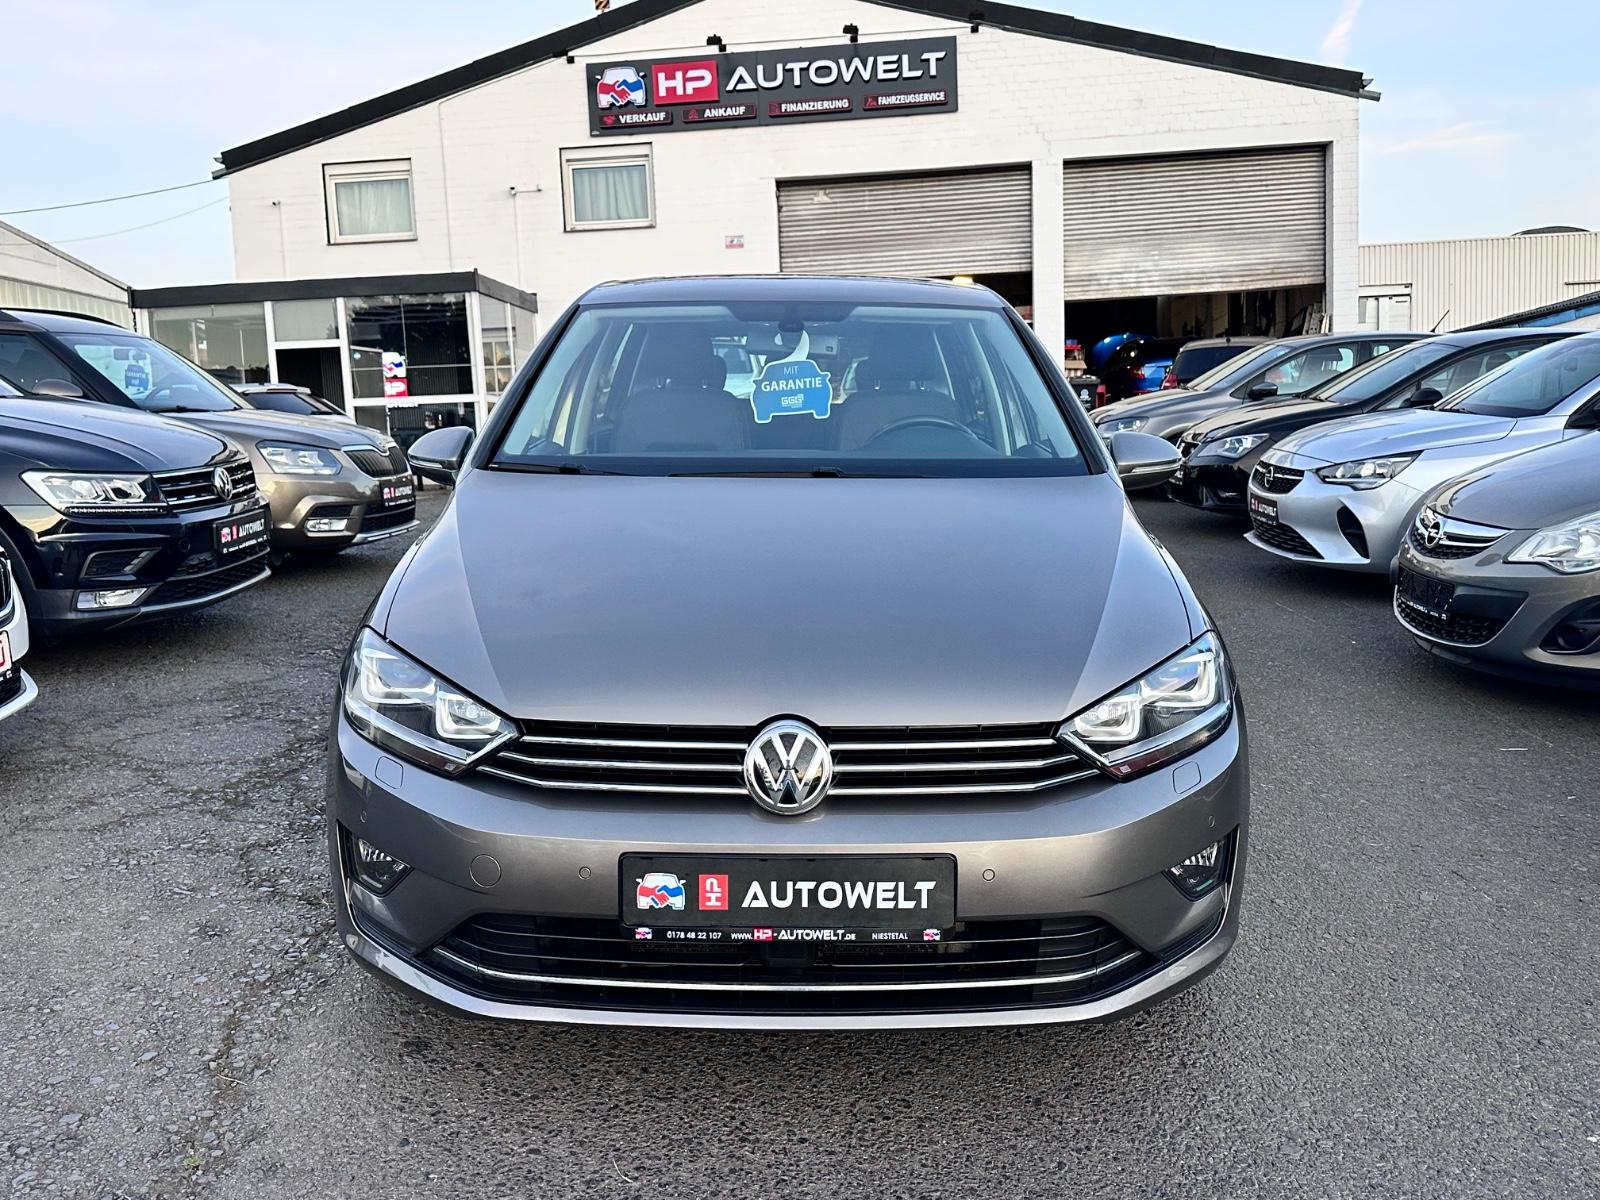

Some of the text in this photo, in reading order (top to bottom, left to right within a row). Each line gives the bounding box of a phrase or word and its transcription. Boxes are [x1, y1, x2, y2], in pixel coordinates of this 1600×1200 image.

[657, 51, 946, 97] HP AUTOWELT
[877, 91, 945, 105] FAHRZEUGSERVICE
[703, 106, 746, 118] ANKAUF
[781, 99, 849, 113] FINANZIERUNG
[619, 112, 666, 124] VERKAUF
[783, 365, 799, 375] MIT
[761, 377, 822, 392] GARANTIE
[741, 880, 937, 909] AUTOWELT
[666, 930, 686, 939] 0178
[686, 931, 696, 939] 48
[709, 932, 722, 940] 107
[871, 932, 909, 940] NIESTETAL
